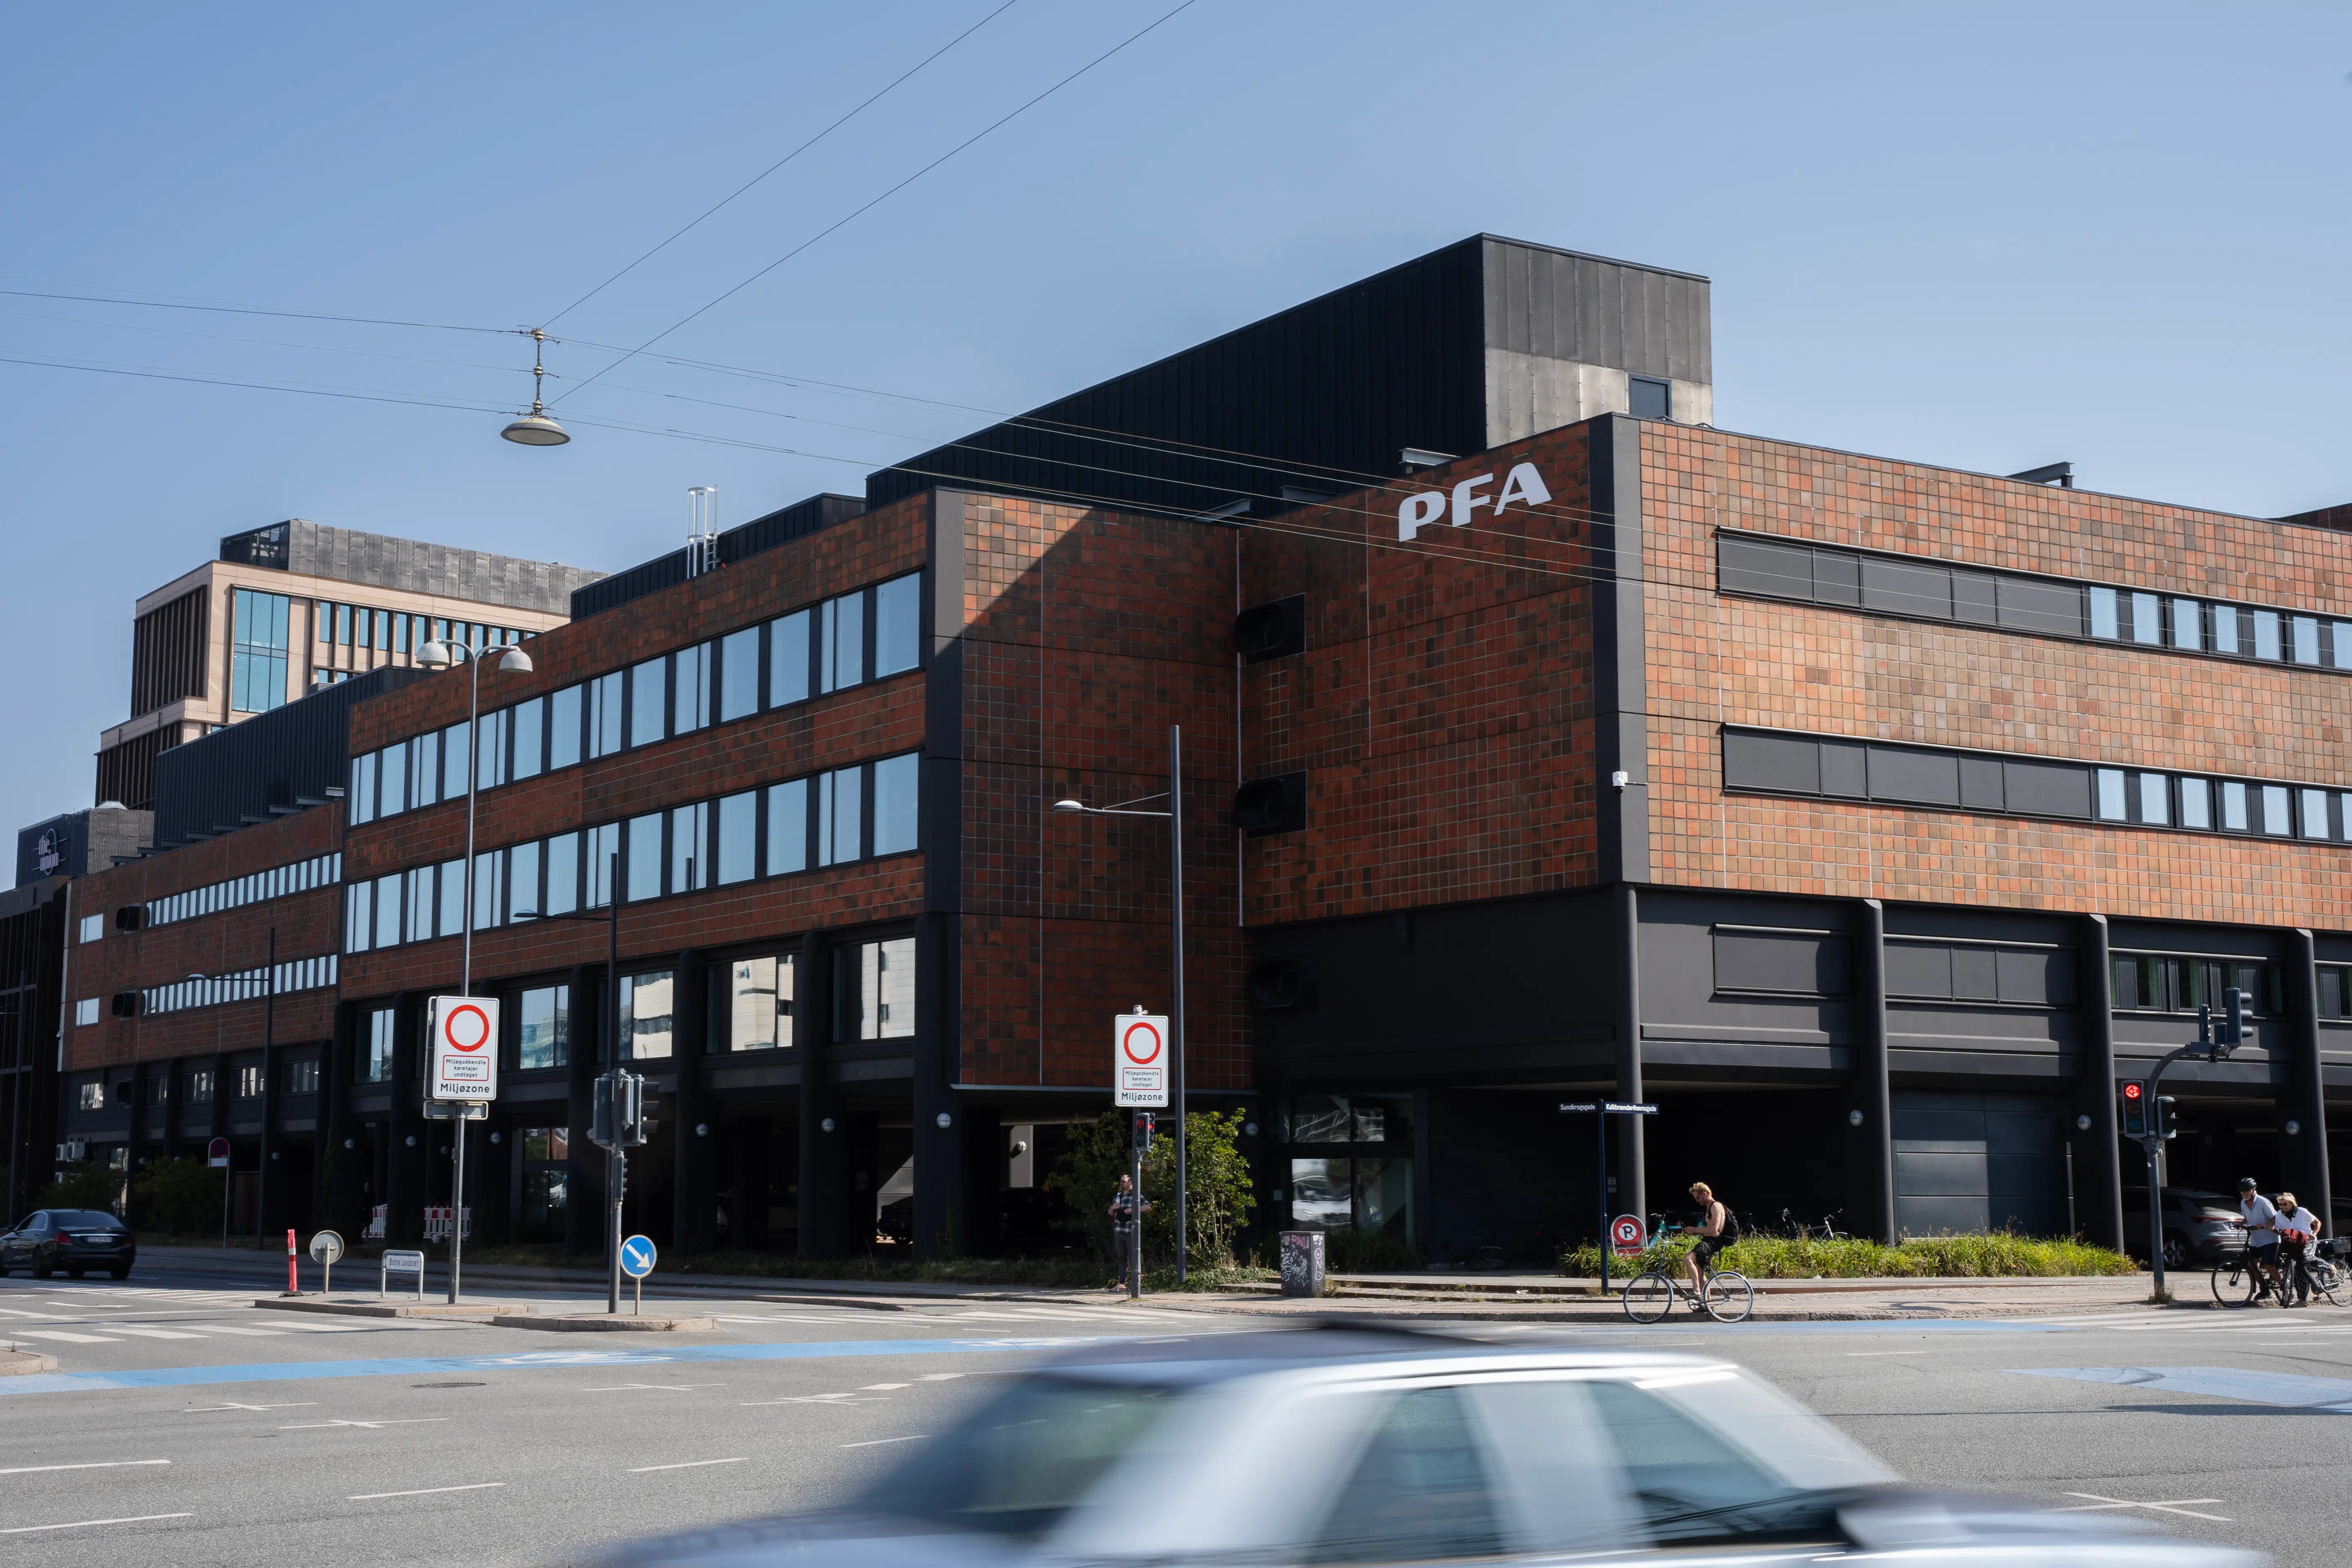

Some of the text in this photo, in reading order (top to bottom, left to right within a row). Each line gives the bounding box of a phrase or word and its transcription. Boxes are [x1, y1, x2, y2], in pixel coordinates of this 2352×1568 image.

[1399, 462, 1552, 542] PFA
[39, 835, 50, 855] the
[40, 850, 59, 871] union
[441, 1083, 490, 1093] Miljøzone
[1122, 1093, 1163, 1101] Miljøzone
[1623, 1226, 1633, 1239] P
[402, 1258, 419, 1267] Landsret
